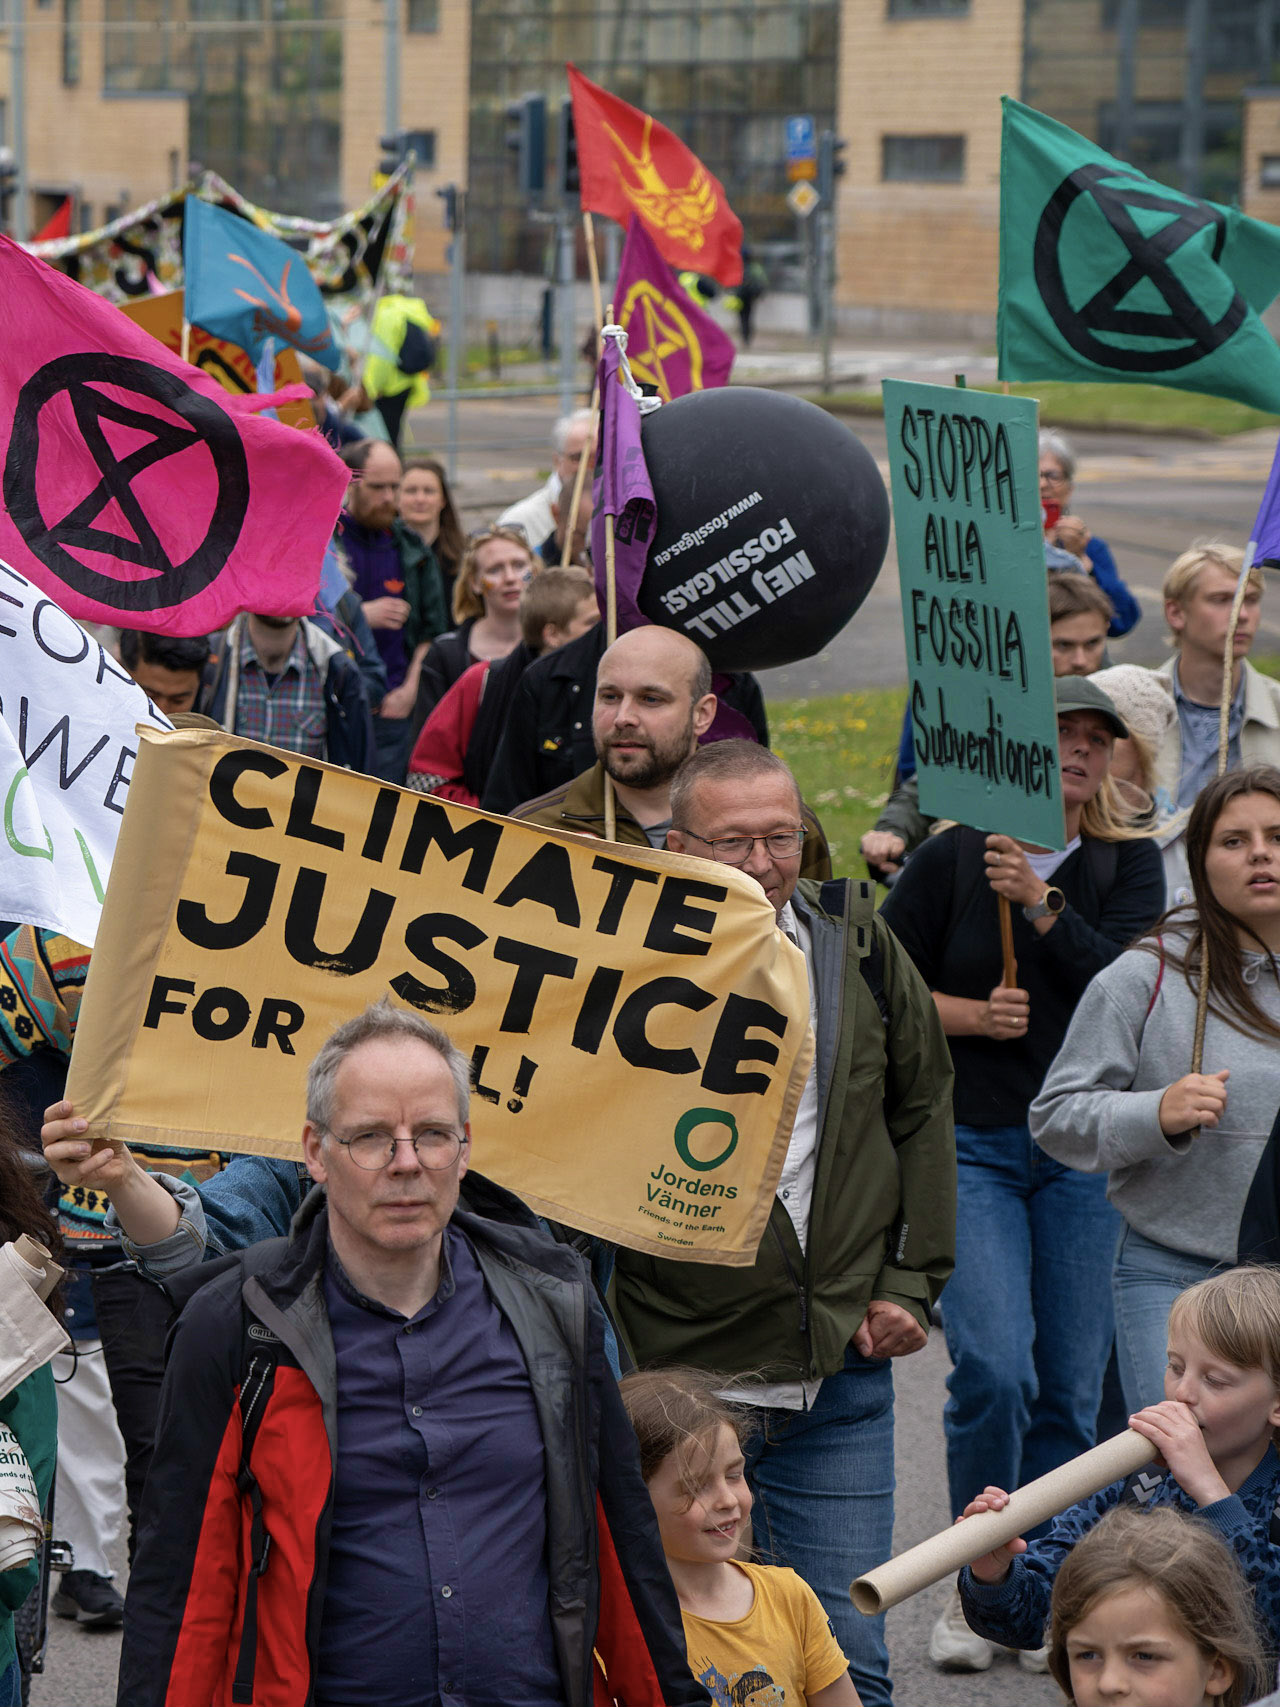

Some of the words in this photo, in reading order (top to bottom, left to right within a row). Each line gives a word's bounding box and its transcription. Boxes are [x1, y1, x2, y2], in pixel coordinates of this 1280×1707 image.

[900, 404, 1019, 528] STOPPA
[654, 491, 763, 567] www.fossilgas.eu
[659, 517, 797, 615] FOSSILGAS!
[925, 512, 987, 585] ALLA
[751, 549, 816, 604] NEJ
[683, 593, 761, 640] TILL
[912, 588, 1028, 693] FOSSILA
[912, 679, 1057, 799] Subventioner
[209, 749, 728, 956] CLIMATE
[177, 850, 789, 1096] JUSTICE
[143, 976, 305, 1055] FOR
[638, 1205, 671, 1225] Friends
[673, 1220, 683, 1229] of
[685, 1223, 700, 1231] the
[701, 1223, 726, 1233] Earth
[646, 1183, 722, 1218] Vänner
[650, 1163, 738, 1199] Jordens
[19, 1472, 26, 1480] of
